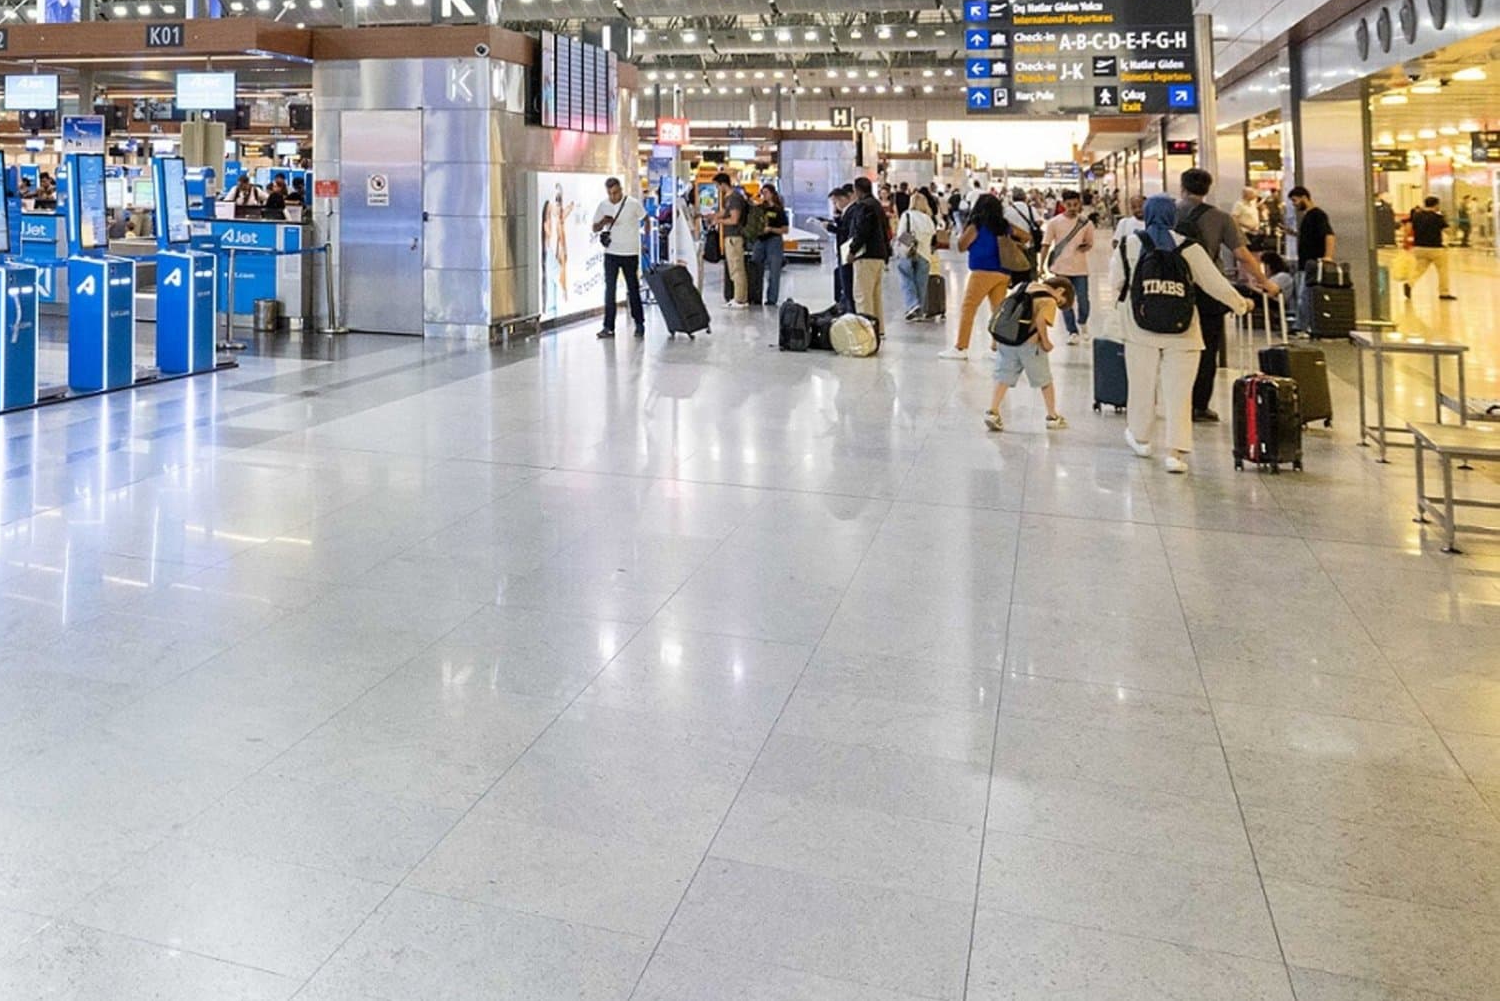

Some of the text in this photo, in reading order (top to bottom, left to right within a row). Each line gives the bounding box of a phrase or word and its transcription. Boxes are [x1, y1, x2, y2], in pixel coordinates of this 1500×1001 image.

[1054, 1, 1080, 13] Giden
[1012, 13, 1114, 26] International Departures
[150, 27, 180, 45] K01
[1014, 32, 1056, 43] Check-in
[1059, 31, 1187, 51] A-B-C-D-E-F-G-H
[1015, 61, 1057, 72] Check-in
[1060, 63, 1084, 80] J-K
[1157, 59, 1185, 70] Giden
[834, 109, 848, 125] H
[220, 228, 259, 245] AJet
